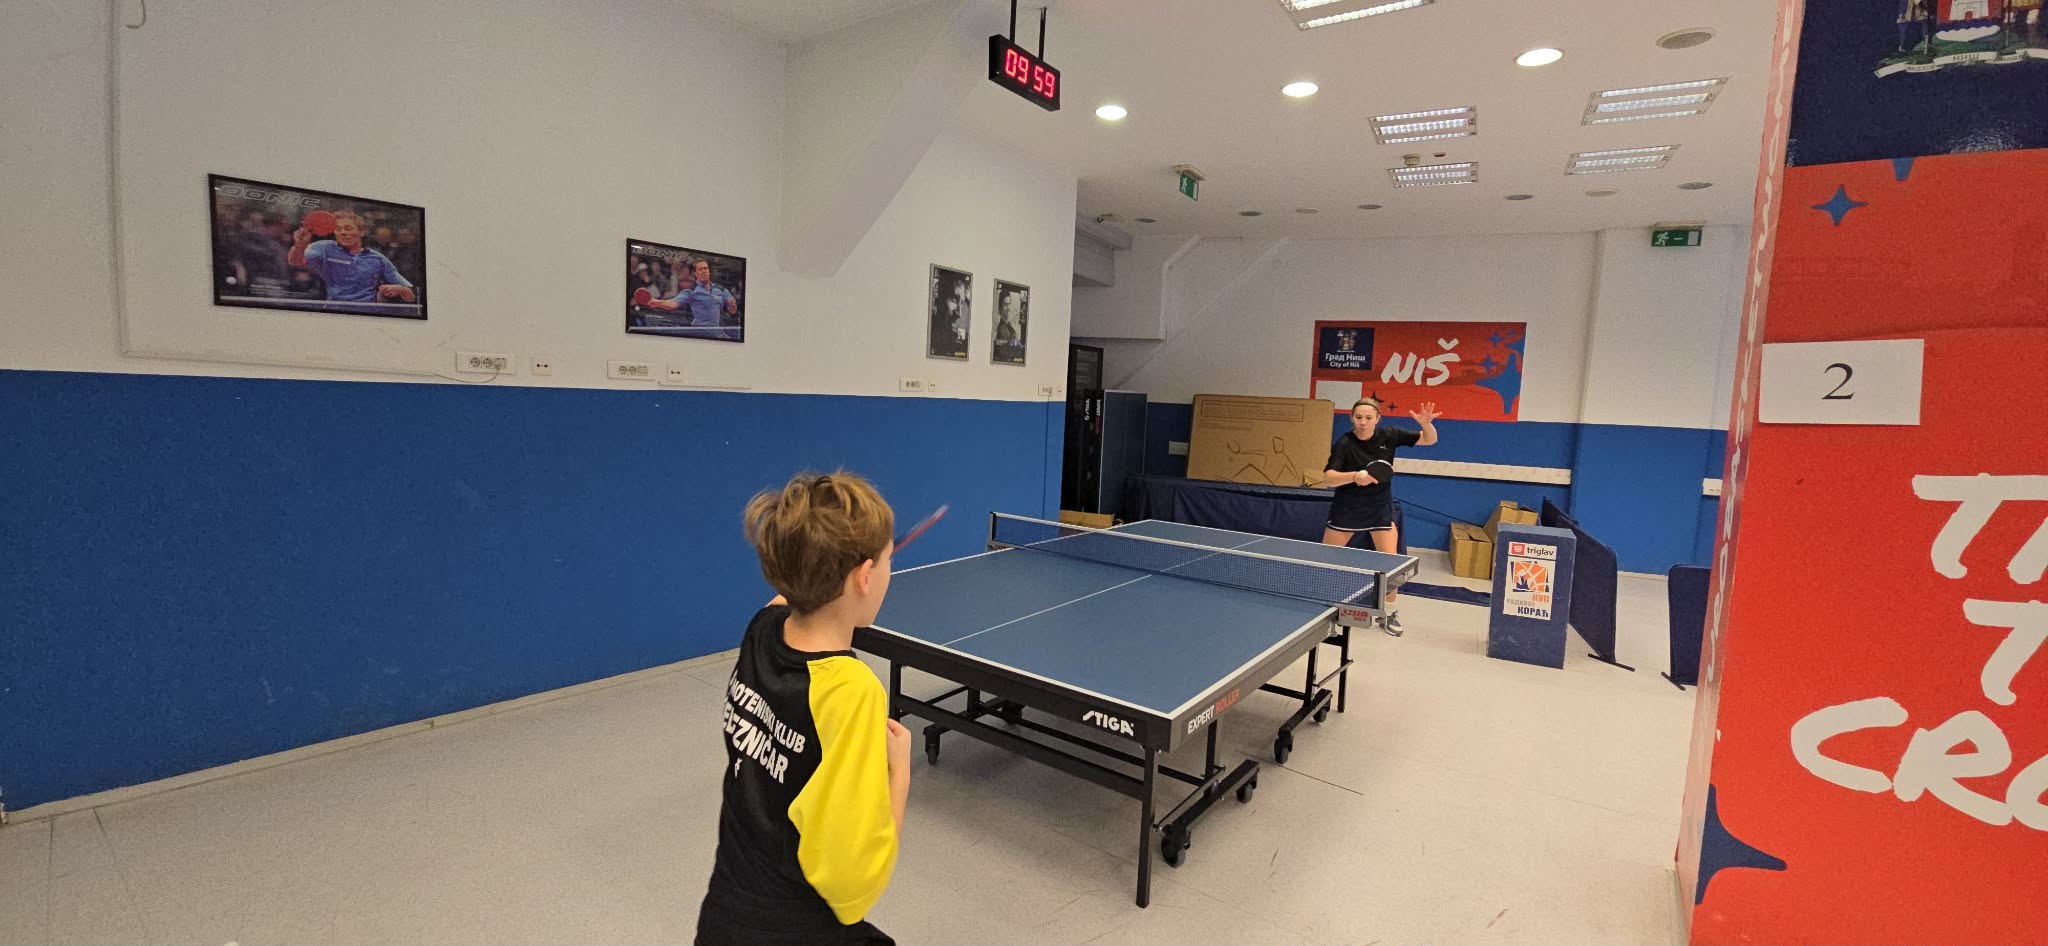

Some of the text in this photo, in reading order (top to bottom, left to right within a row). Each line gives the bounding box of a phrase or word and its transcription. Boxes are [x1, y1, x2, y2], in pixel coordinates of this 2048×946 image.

[217, 184, 321, 208] DONIC
[1325, 353, 1366, 361] Град Ниш
[1380, 338, 1460, 386] NIŠ
[1821, 362, 1855, 400] 2
[1527, 547, 1554, 556] triglav
[1517, 606, 1548, 617] КОРАЋ
[1082, 710, 1135, 737] STIGA
[1187, 688, 1240, 735] EXPERT ROLLER
[774, 719, 806, 754] KLUB
